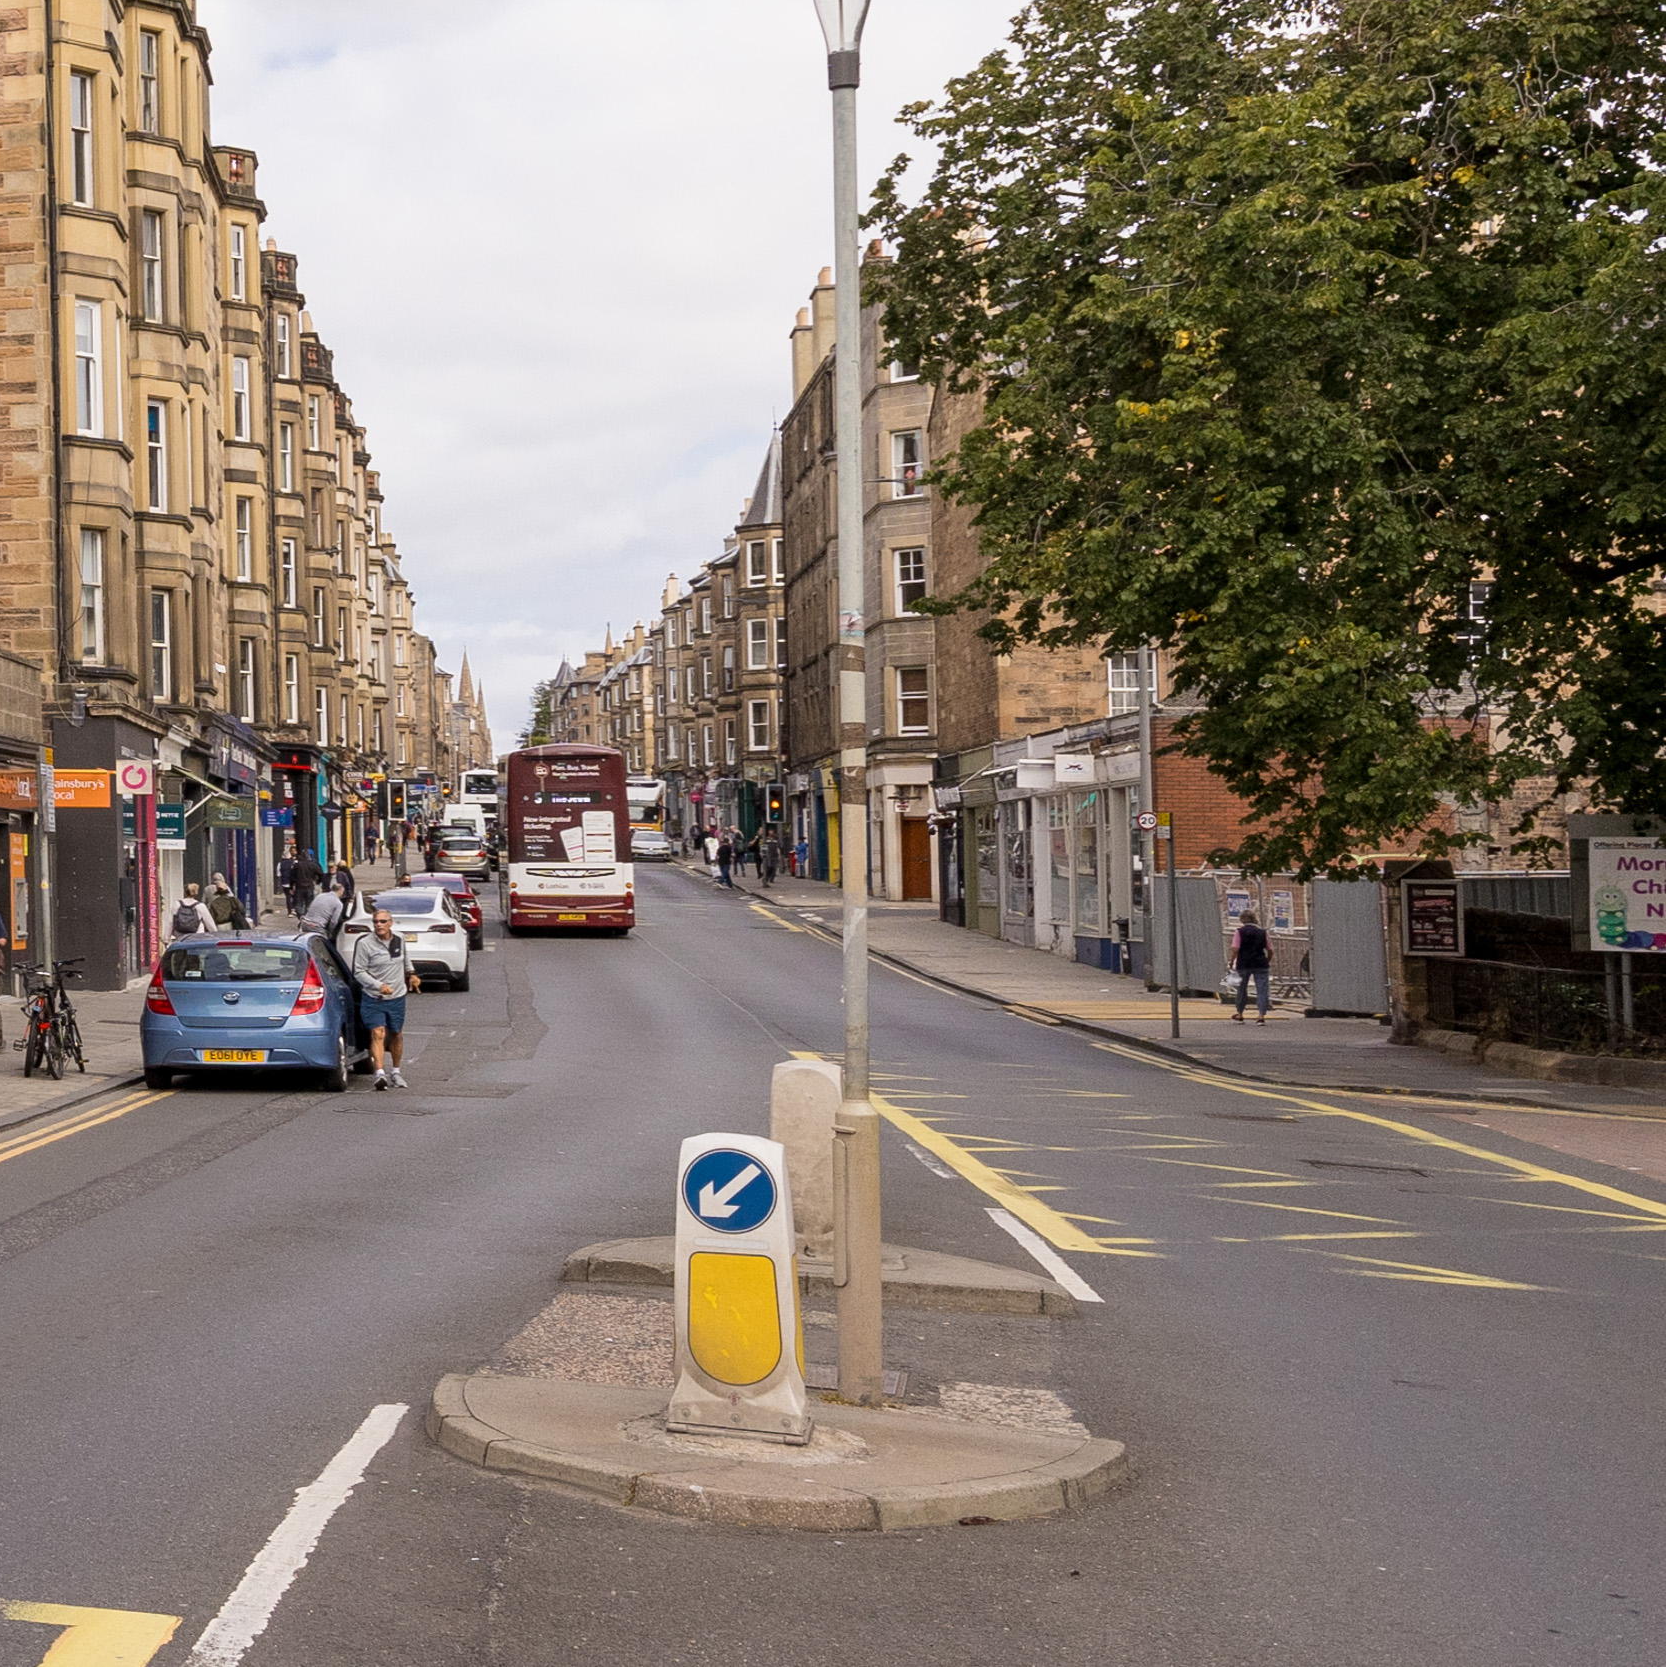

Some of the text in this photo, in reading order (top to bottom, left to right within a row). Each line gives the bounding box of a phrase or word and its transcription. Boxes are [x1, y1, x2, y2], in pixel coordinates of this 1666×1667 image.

[54, 779, 105, 790] ainsbury's
[53, 790, 75, 800] ocal
[1617, 857, 1666, 871] Mor
[1632, 879, 1666, 894] Ch
